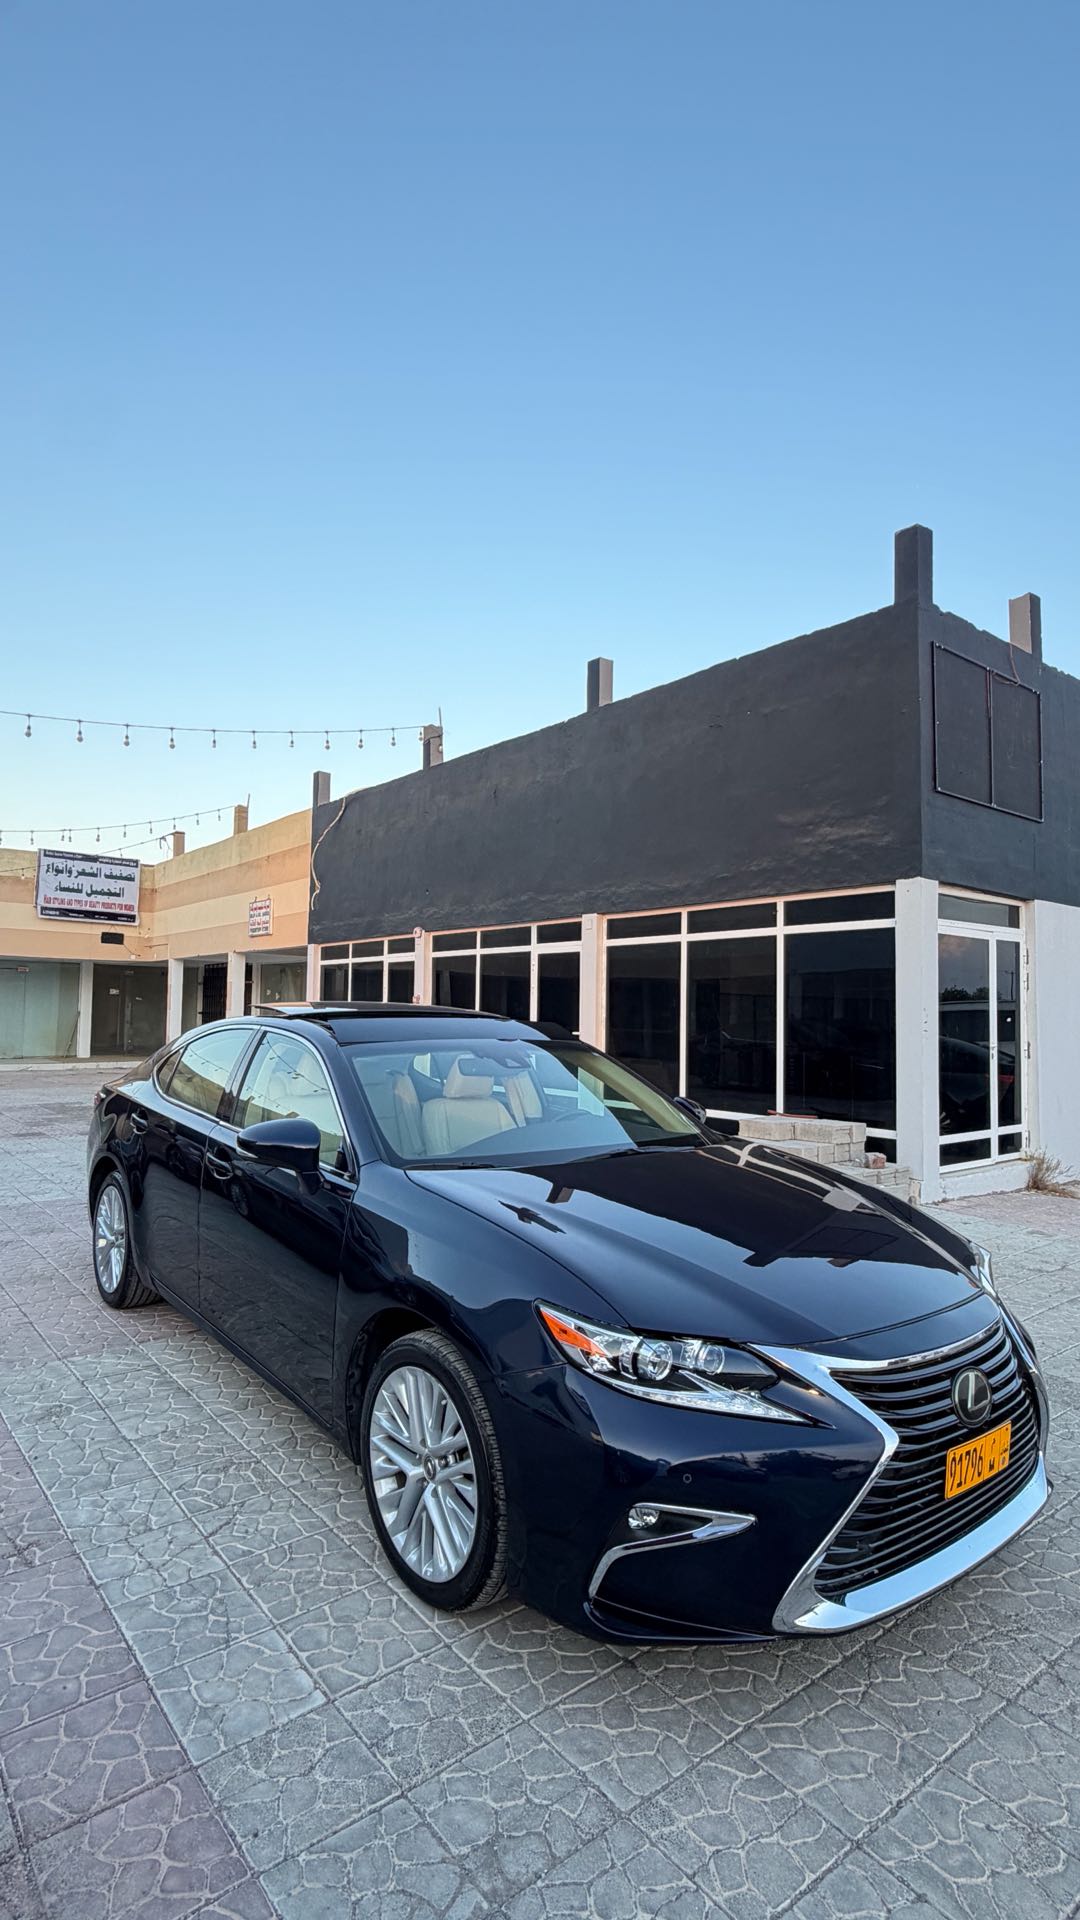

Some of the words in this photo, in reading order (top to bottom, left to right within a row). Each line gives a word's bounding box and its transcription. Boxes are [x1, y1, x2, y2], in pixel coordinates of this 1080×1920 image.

[45, 860, 73, 878] وأنواع
[73, 866, 102, 879] الشعر
[104, 868, 136, 883] تصفيف
[54, 881, 83, 894] للنساء
[85, 884, 125, 900] التجميل
[949, 1443, 984, 1492] 91796
